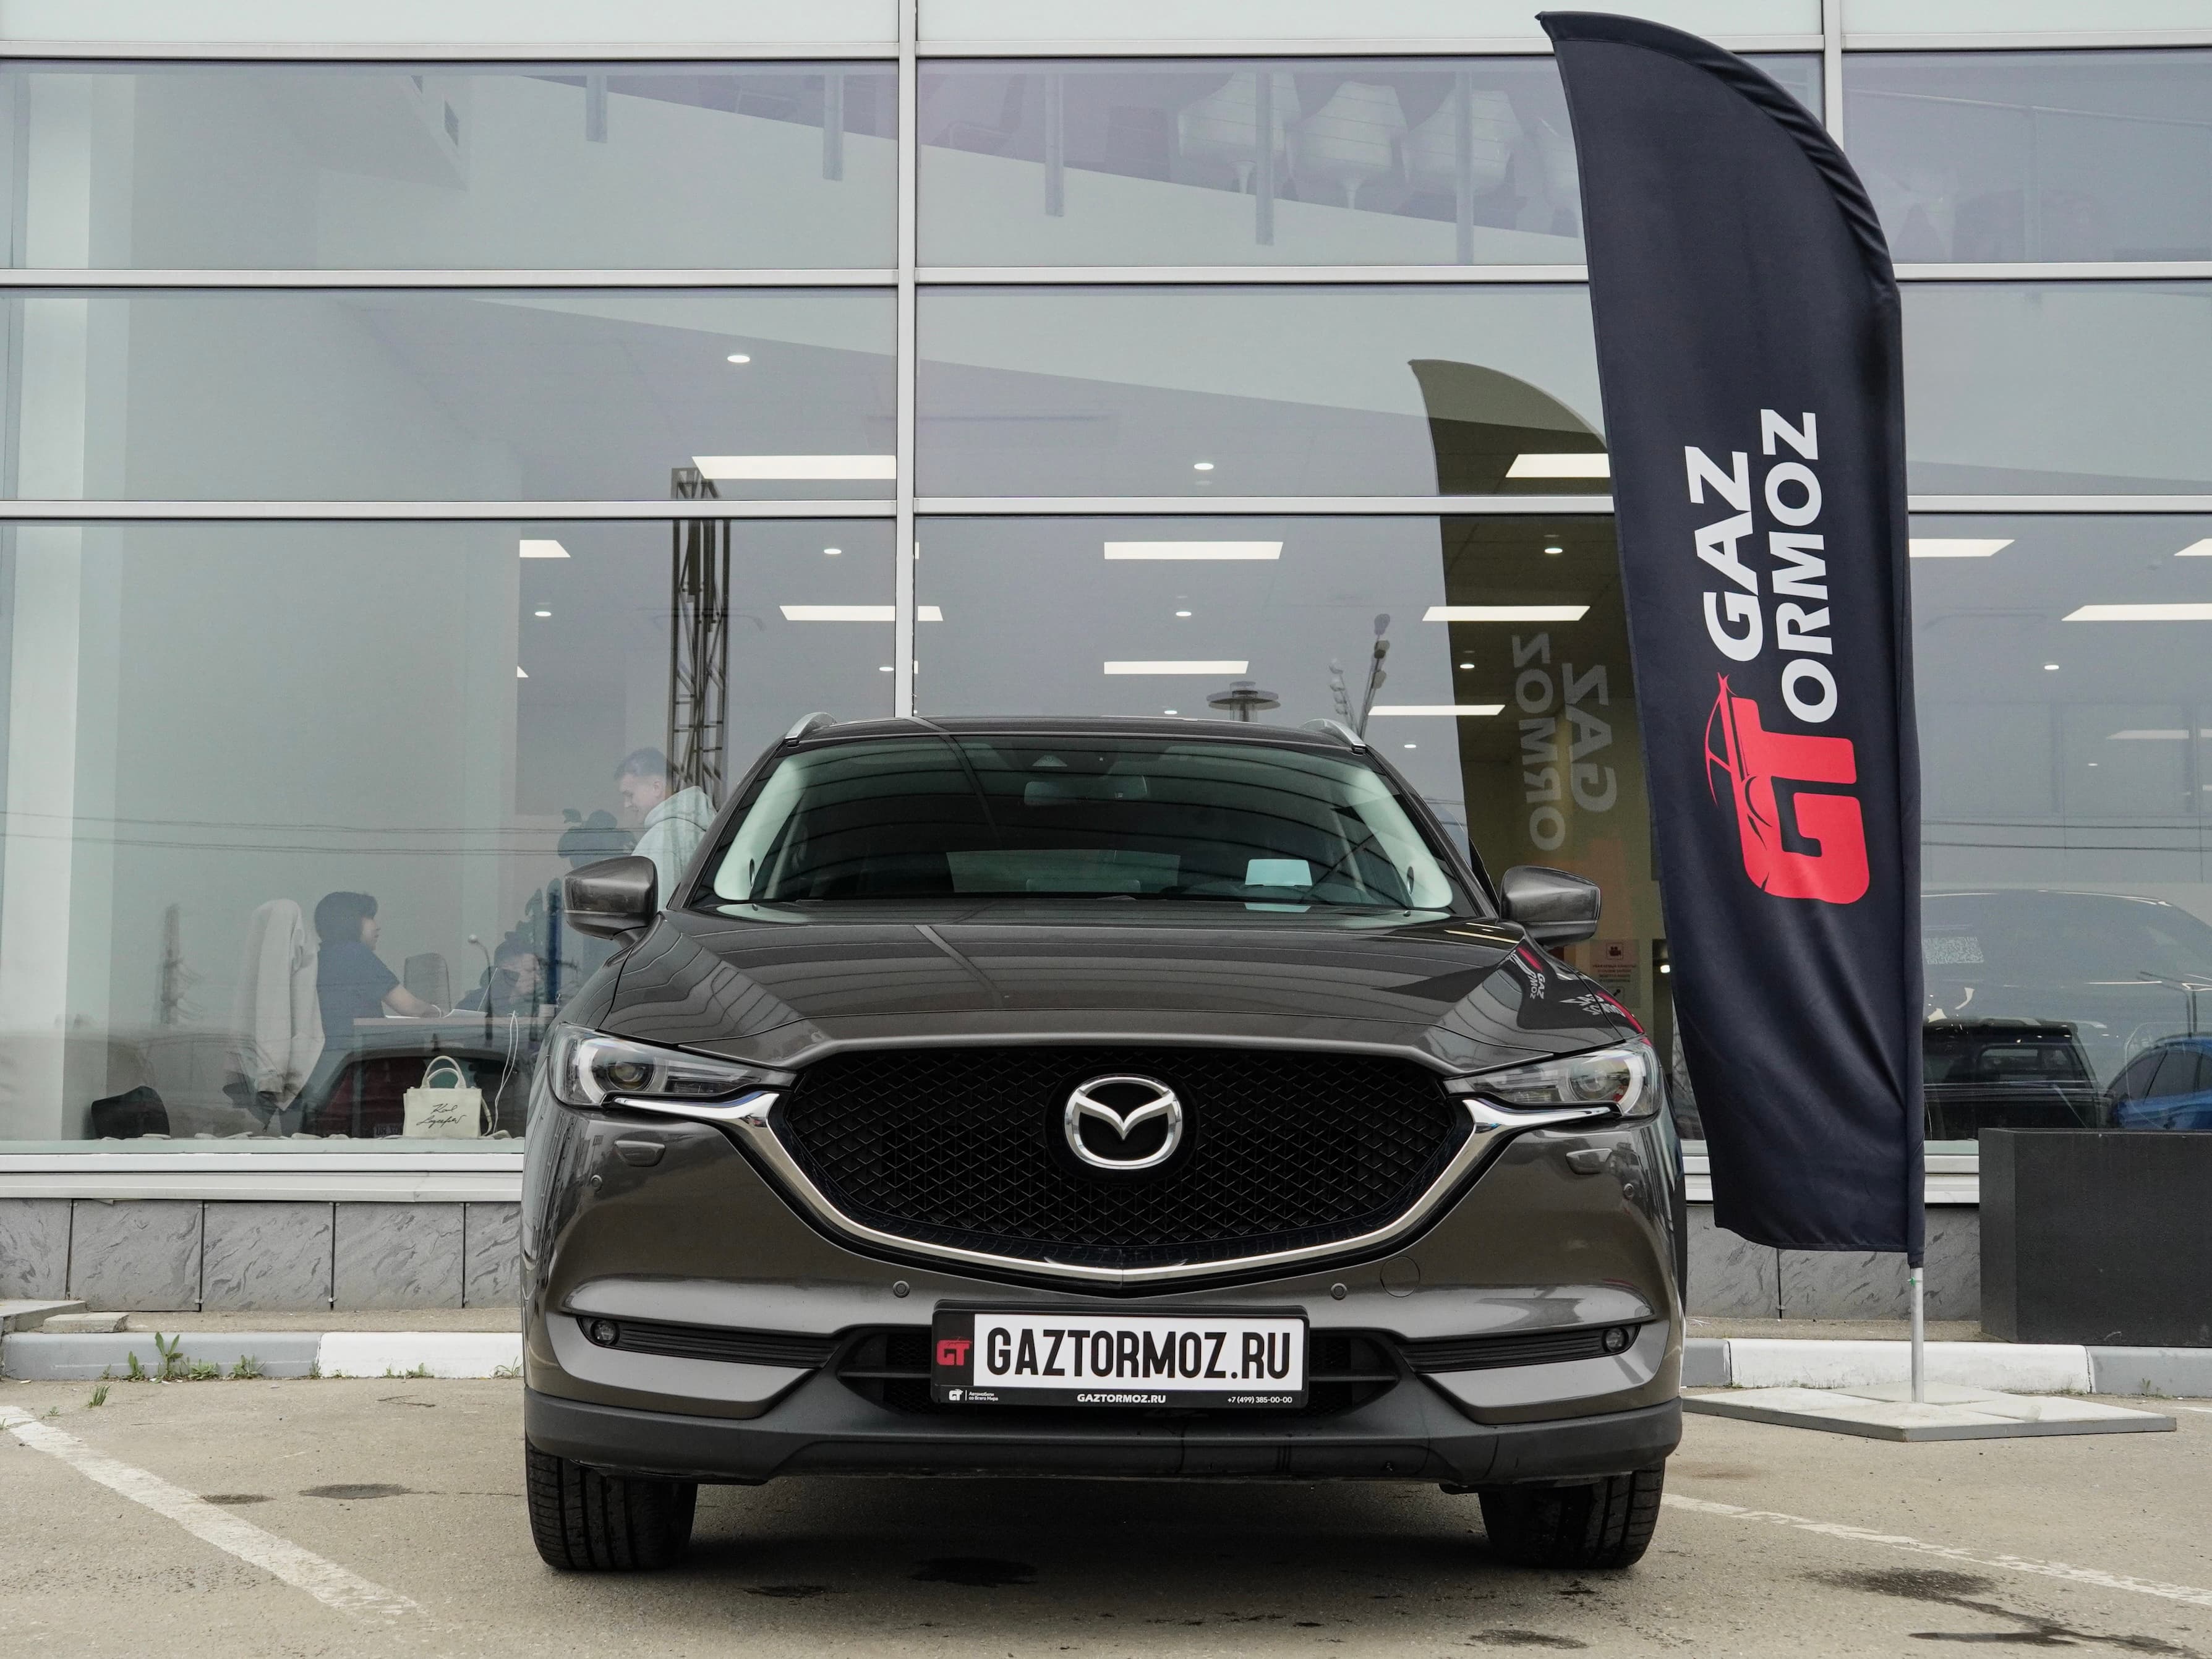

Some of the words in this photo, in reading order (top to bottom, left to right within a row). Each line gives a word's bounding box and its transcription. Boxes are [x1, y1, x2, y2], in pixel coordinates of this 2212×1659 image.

[1685, 446, 1763, 662] GAZ
[1761, 409, 1837, 722] ORMOZ
[987, 1327, 1291, 1380] GAZTORMOZ.RU
[1077, 1394, 1166, 1403] GAZTORMOZ.RU
